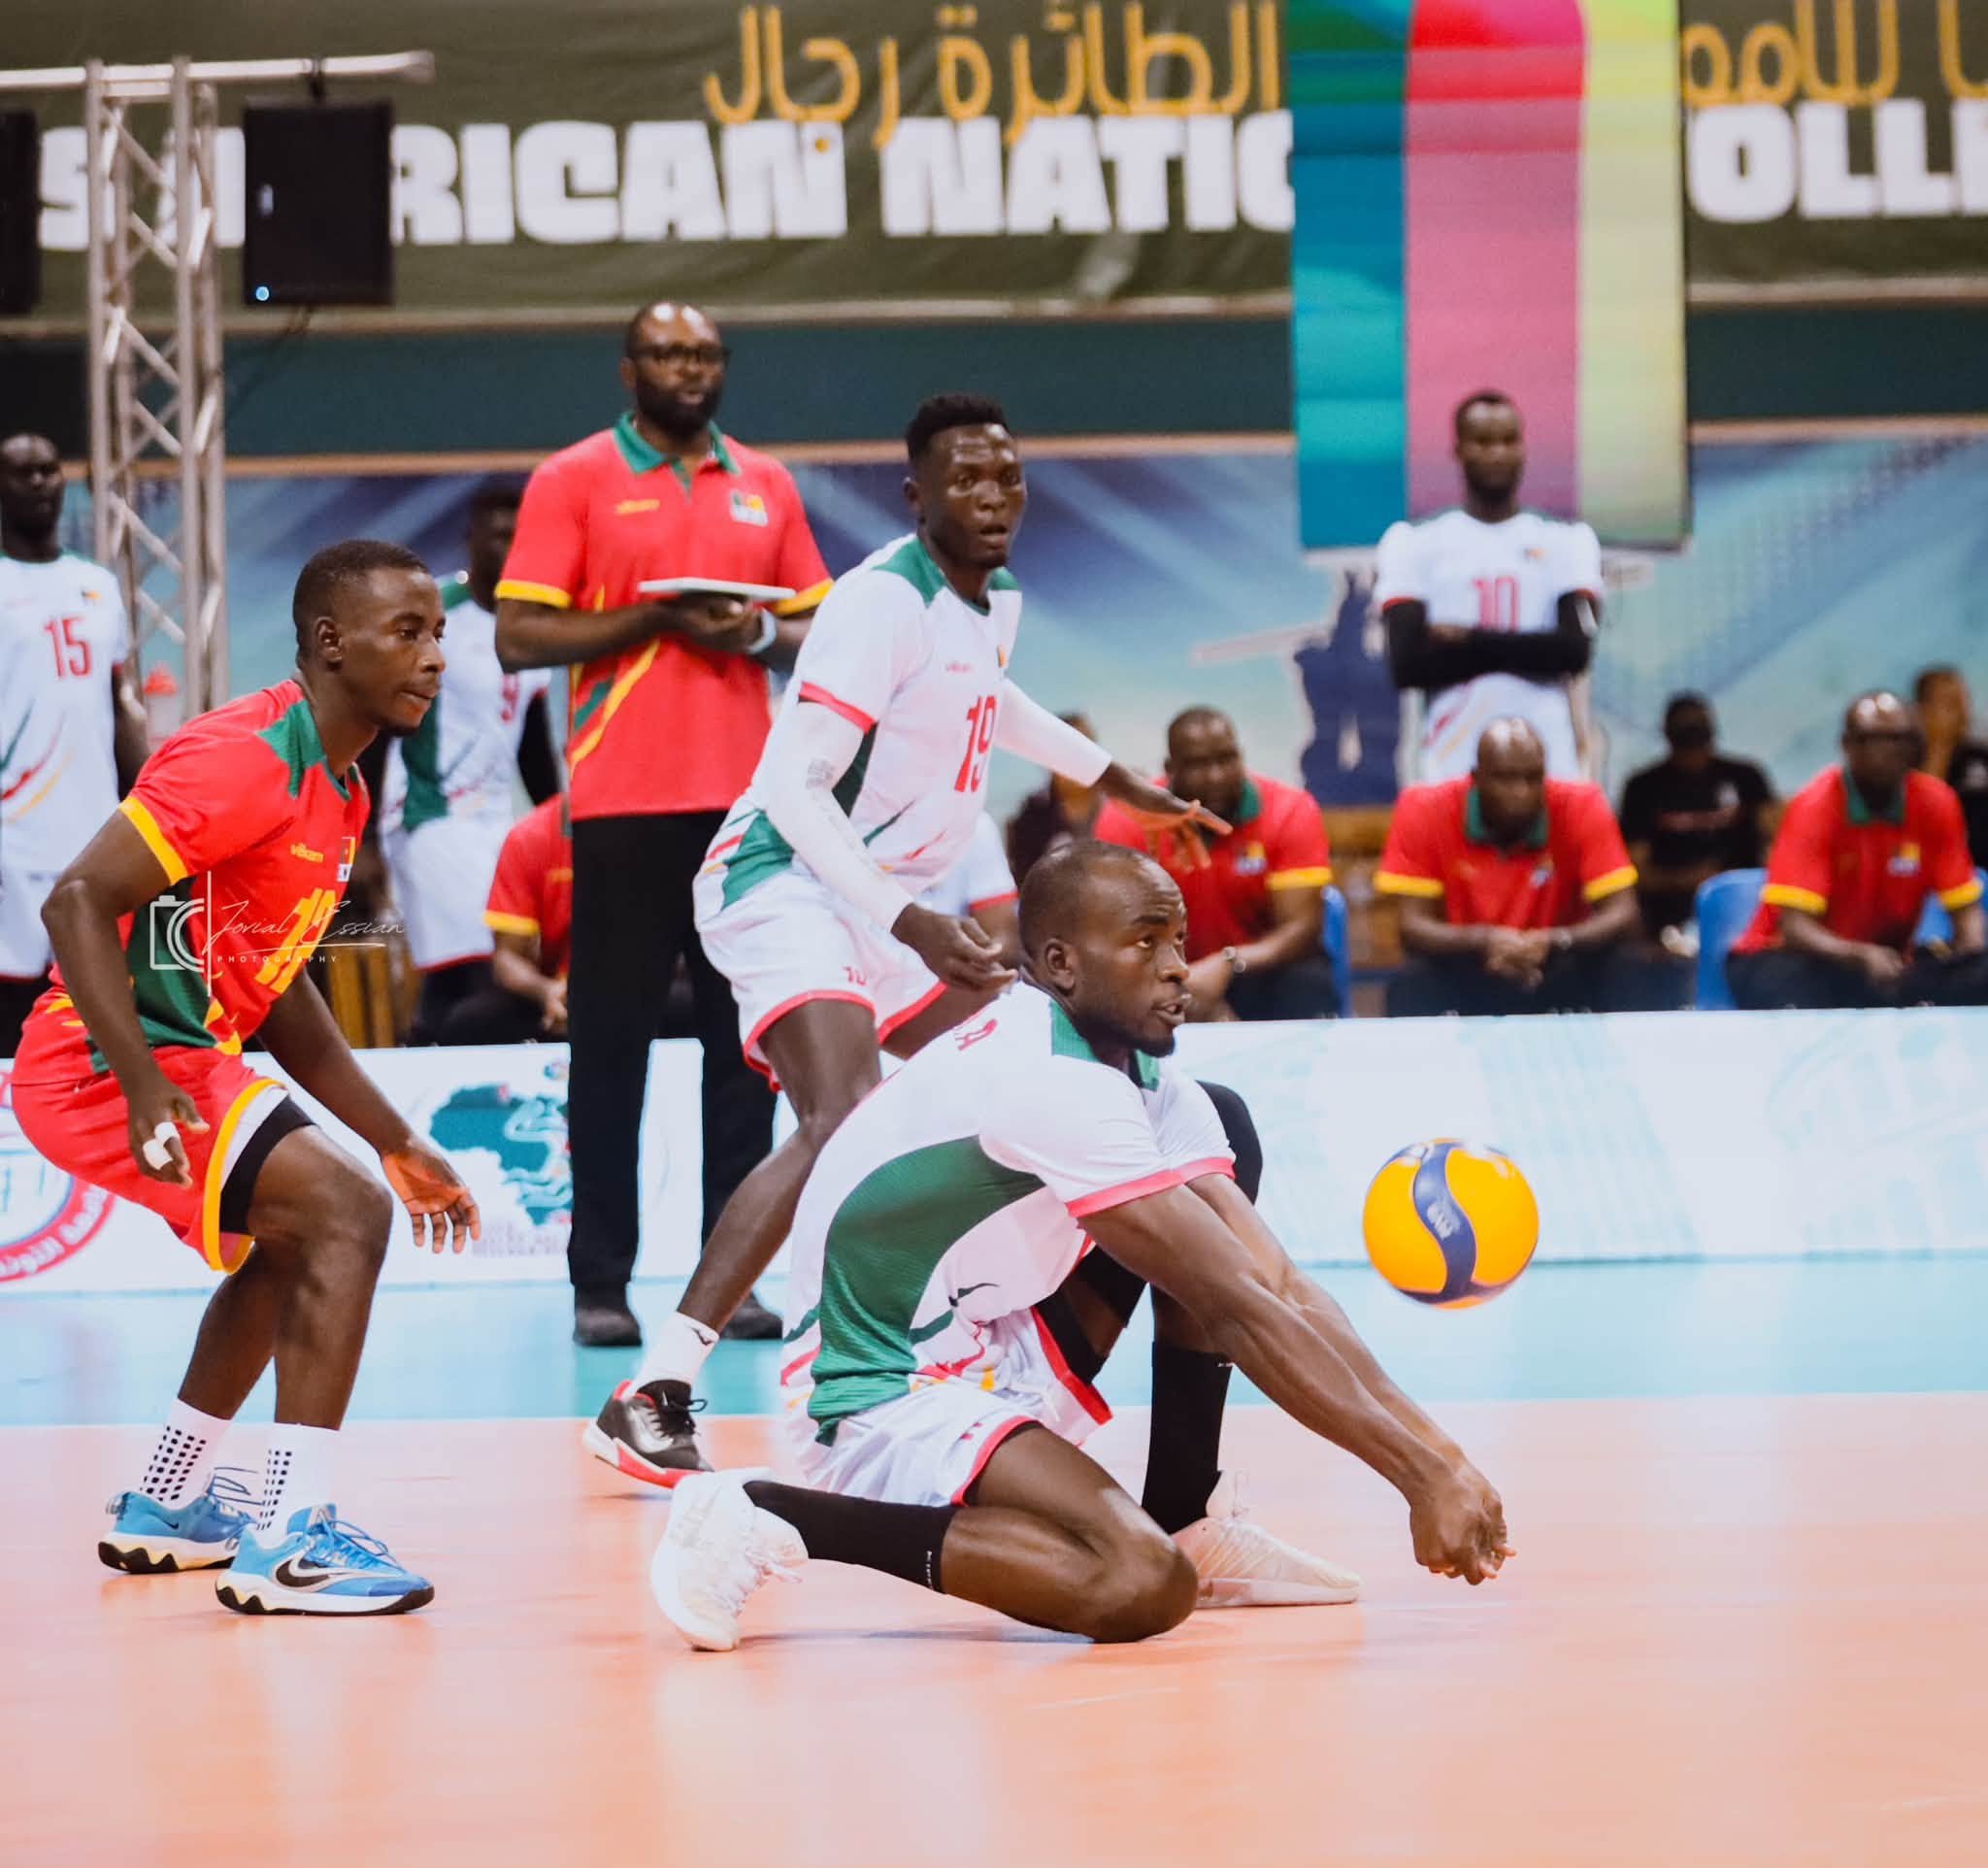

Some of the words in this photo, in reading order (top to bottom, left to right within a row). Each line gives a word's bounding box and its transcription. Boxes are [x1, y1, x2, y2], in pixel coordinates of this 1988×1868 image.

[703, 3, 904, 153] رجال
[43, 616, 91, 679] 15
[954, 694, 998, 793] 19
